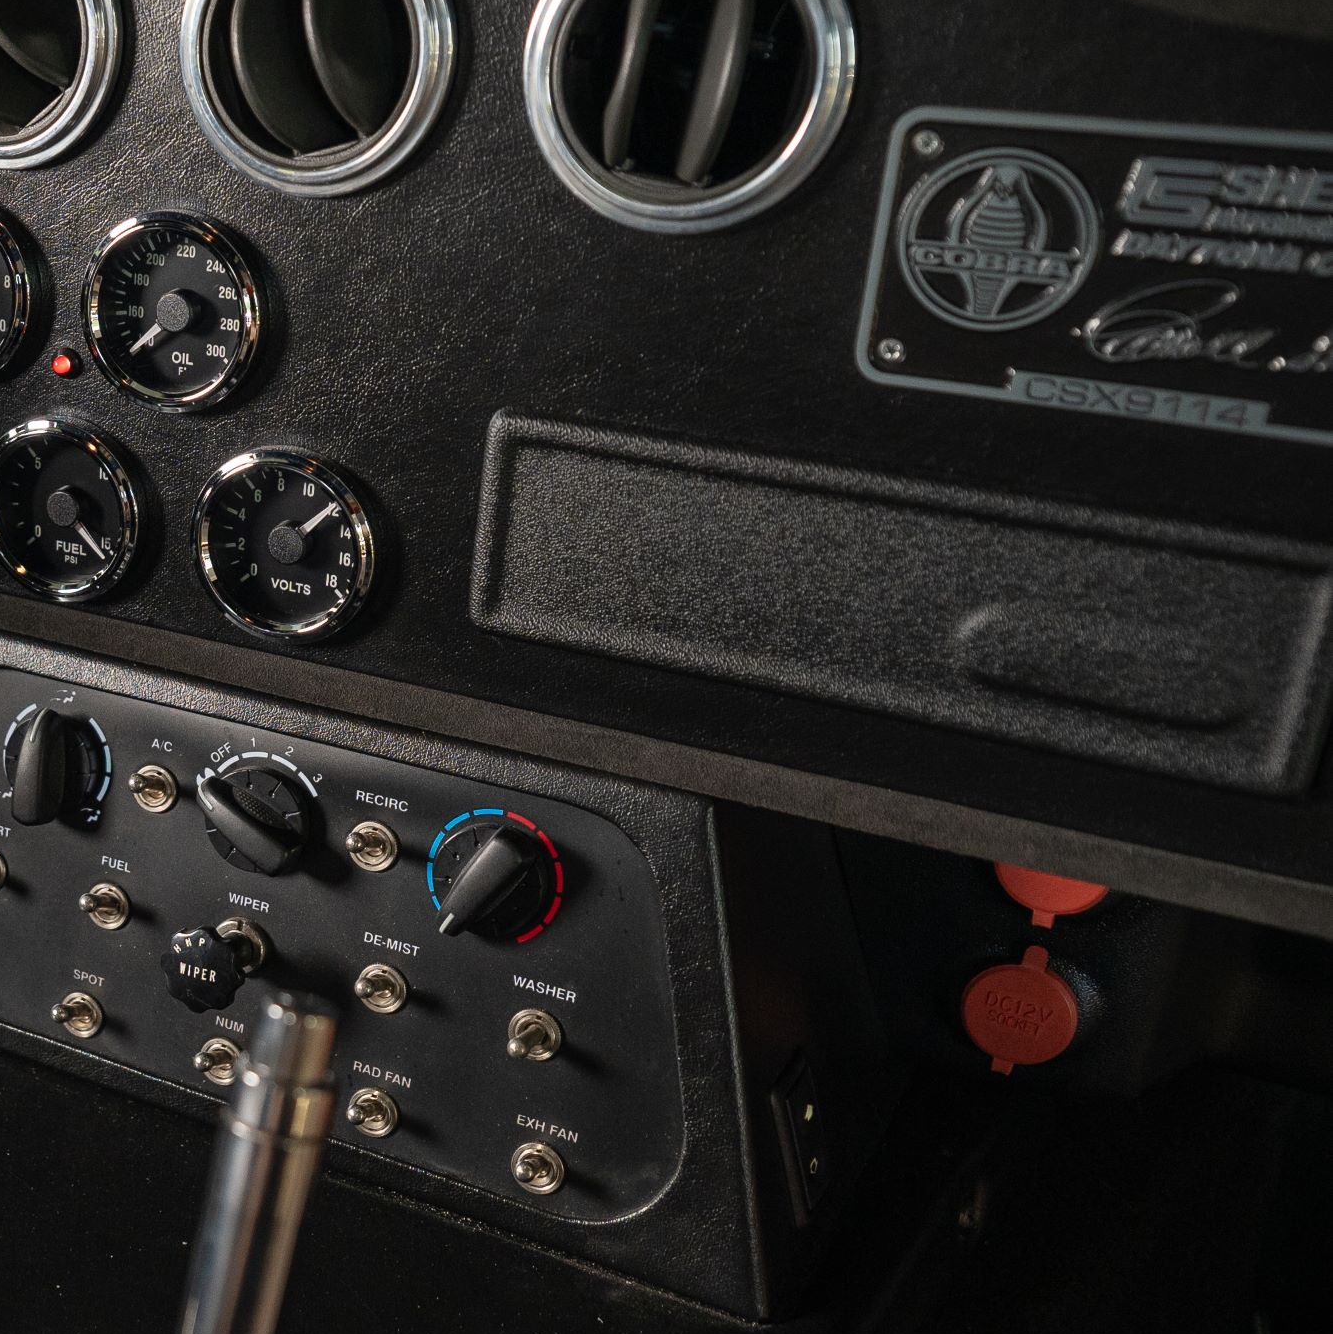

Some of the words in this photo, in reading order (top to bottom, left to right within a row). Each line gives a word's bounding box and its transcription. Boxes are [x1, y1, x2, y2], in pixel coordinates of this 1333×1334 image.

[176, 245, 196, 258] 220
[146, 253, 165, 267] 200
[908, 242, 1078, 279] COBRA
[133, 273, 150, 287] 180
[128, 305, 144, 318] 160
[220, 318, 240, 332] 280
[171, 351, 194, 366] OIL
[206, 344, 226, 358] 300
[1026, 376, 1250, 427] CSX9114
[34, 457, 42, 469] 5
[277, 478, 285, 492] 8
[302, 482, 315, 498] 10
[254, 489, 262, 503] 6
[237, 507, 246, 521] 4
[34, 524, 42, 538] 0
[340, 524, 352, 540] 14
[55, 539, 87, 557] FUEL
[100, 536, 112, 550] 15
[237, 537, 246, 551] 2
[64, 554, 78, 565] PSI
[339, 552, 351, 567] 16
[249, 563, 258, 576] 0
[270, 577, 311, 596] VOLTS
[325, 573, 338, 588] 18
[151, 738, 174, 753] A/C
[250, 737, 256, 748] 1
[210, 742, 233, 763] OFF
[284, 745, 294, 757] 2
[312, 772, 323, 783] 3
[355, 789, 409, 812] RECIRC
[100, 855, 131, 873] FUEL
[228, 891, 270, 913] WIPER
[198, 937, 206, 947] P
[363, 930, 420, 957] DE-MIST
[73, 968, 106, 987] SPOT
[179, 961, 217, 983] WIPER
[513, 974, 577, 1004] WASHER
[984, 990, 1054, 1023] DC12V
[215, 1015, 245, 1034] NUM
[986, 1007, 1042, 1036] SOCKET
[353, 1060, 382, 1080] RAD
[384, 1070, 412, 1089] FAN
[516, 1113, 546, 1133] EXH
[549, 1124, 579, 1144] FAN
